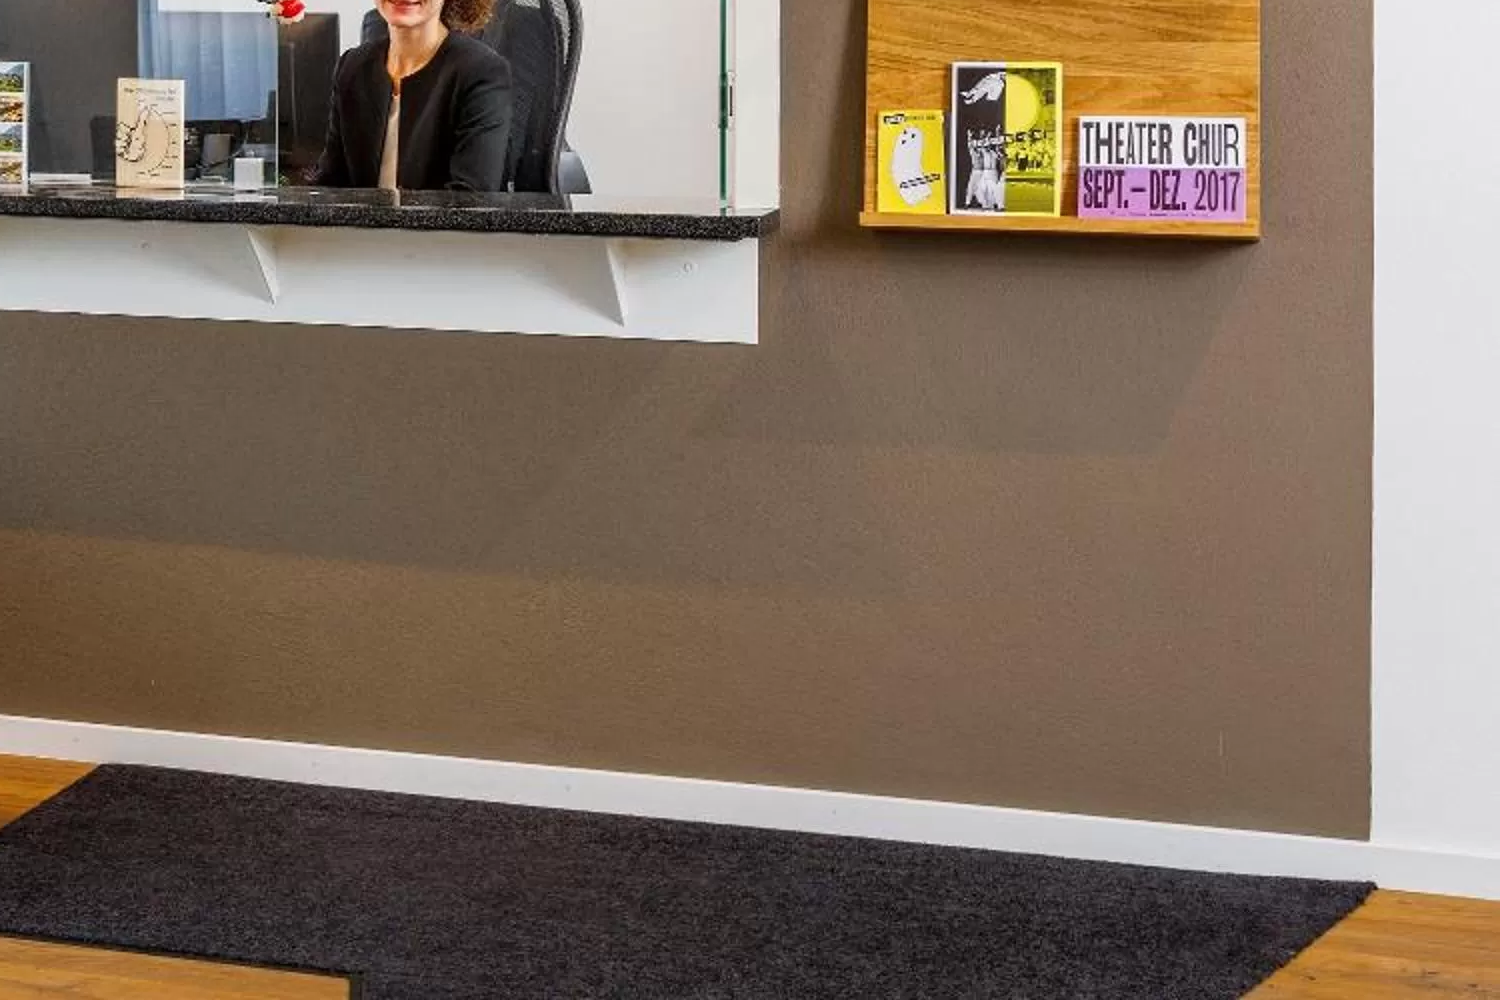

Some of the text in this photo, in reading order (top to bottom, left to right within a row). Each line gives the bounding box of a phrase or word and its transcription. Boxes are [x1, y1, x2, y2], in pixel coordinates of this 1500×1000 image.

[1082, 121, 1240, 167] THEATER CHUR
[1194, 169, 1241, 212] 2017
